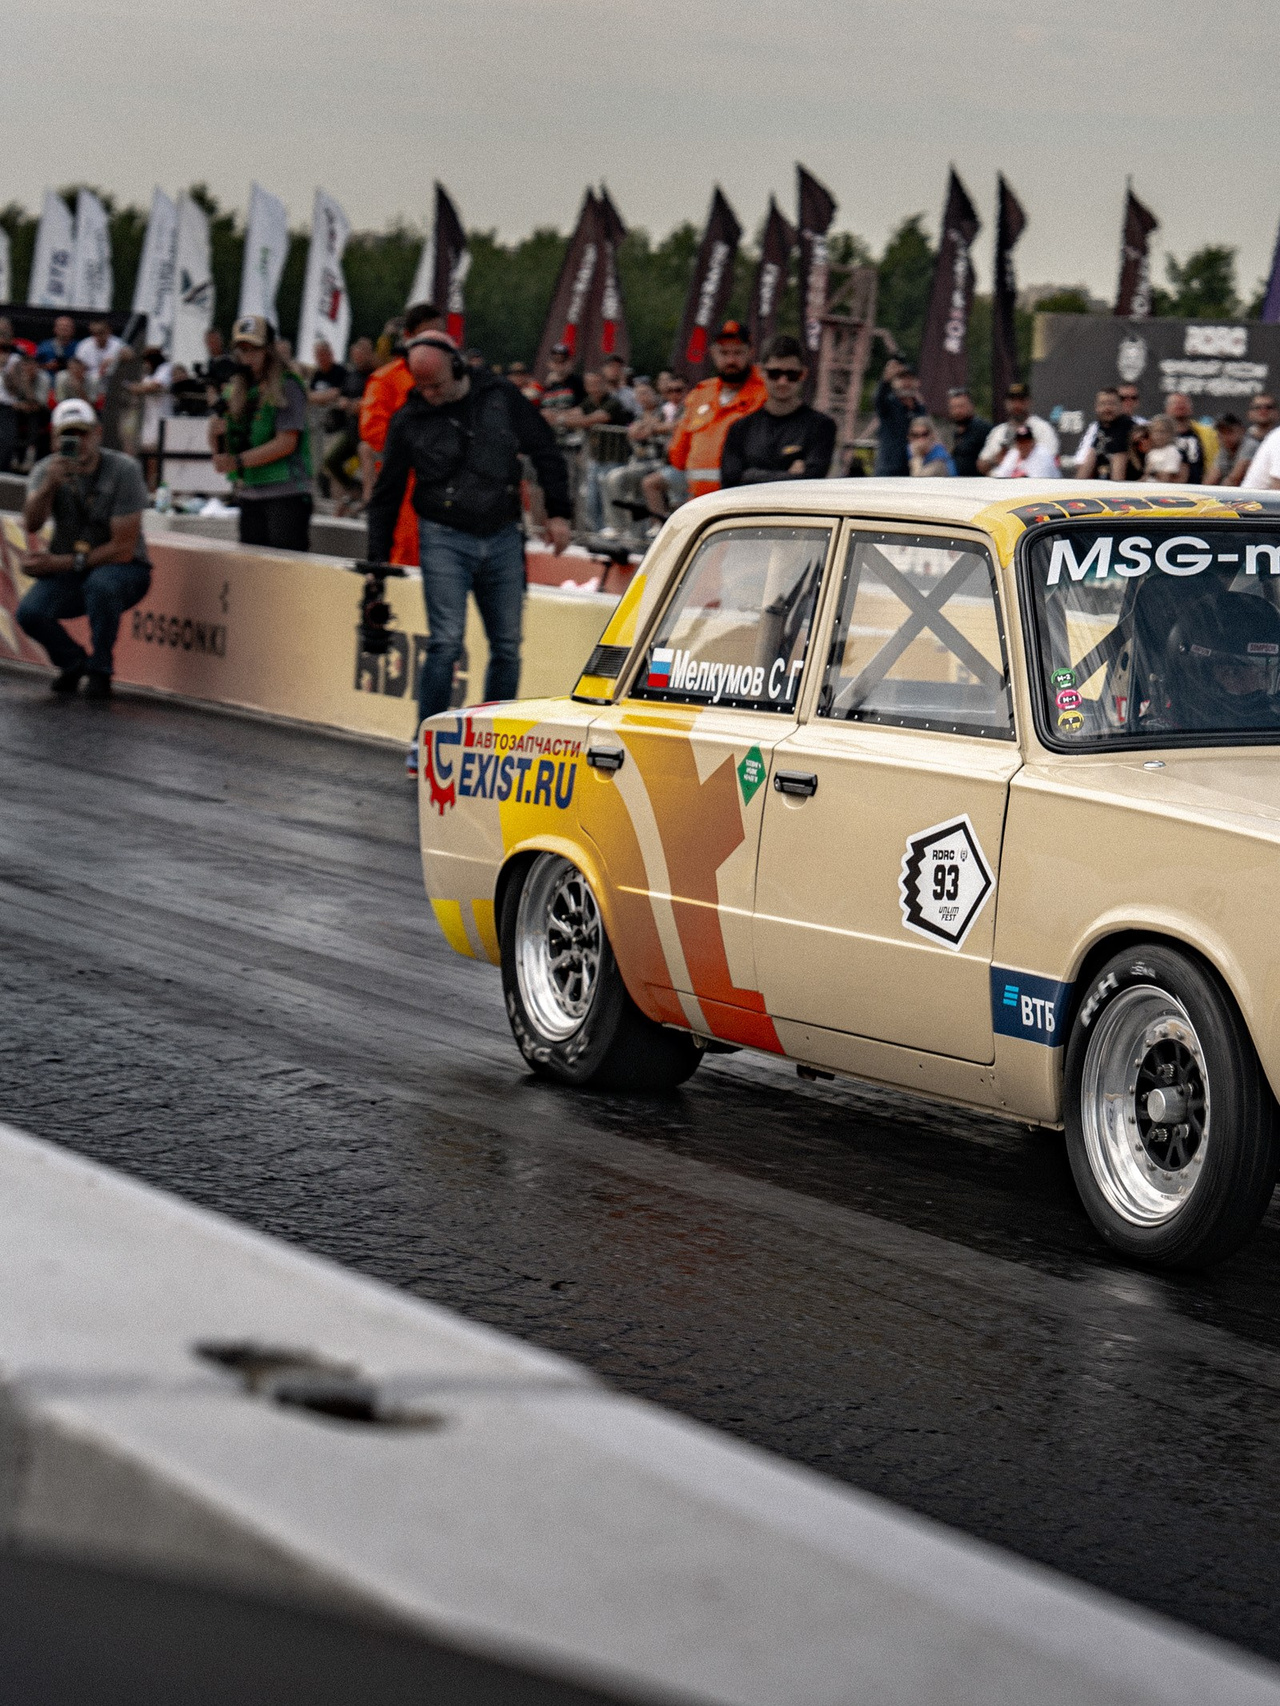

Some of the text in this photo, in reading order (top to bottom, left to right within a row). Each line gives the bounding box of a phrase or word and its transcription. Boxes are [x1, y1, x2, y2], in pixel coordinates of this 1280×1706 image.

[669, 649, 804, 703] Мелкумов С Г
[475, 731, 582, 758] АВТОЗАПЧАСТИ
[458, 751, 577, 809] EXIST.RU
[932, 849, 955, 860] RDRC
[932, 864, 960, 901] 93
[1020, 994, 1056, 1033] ВТБ
